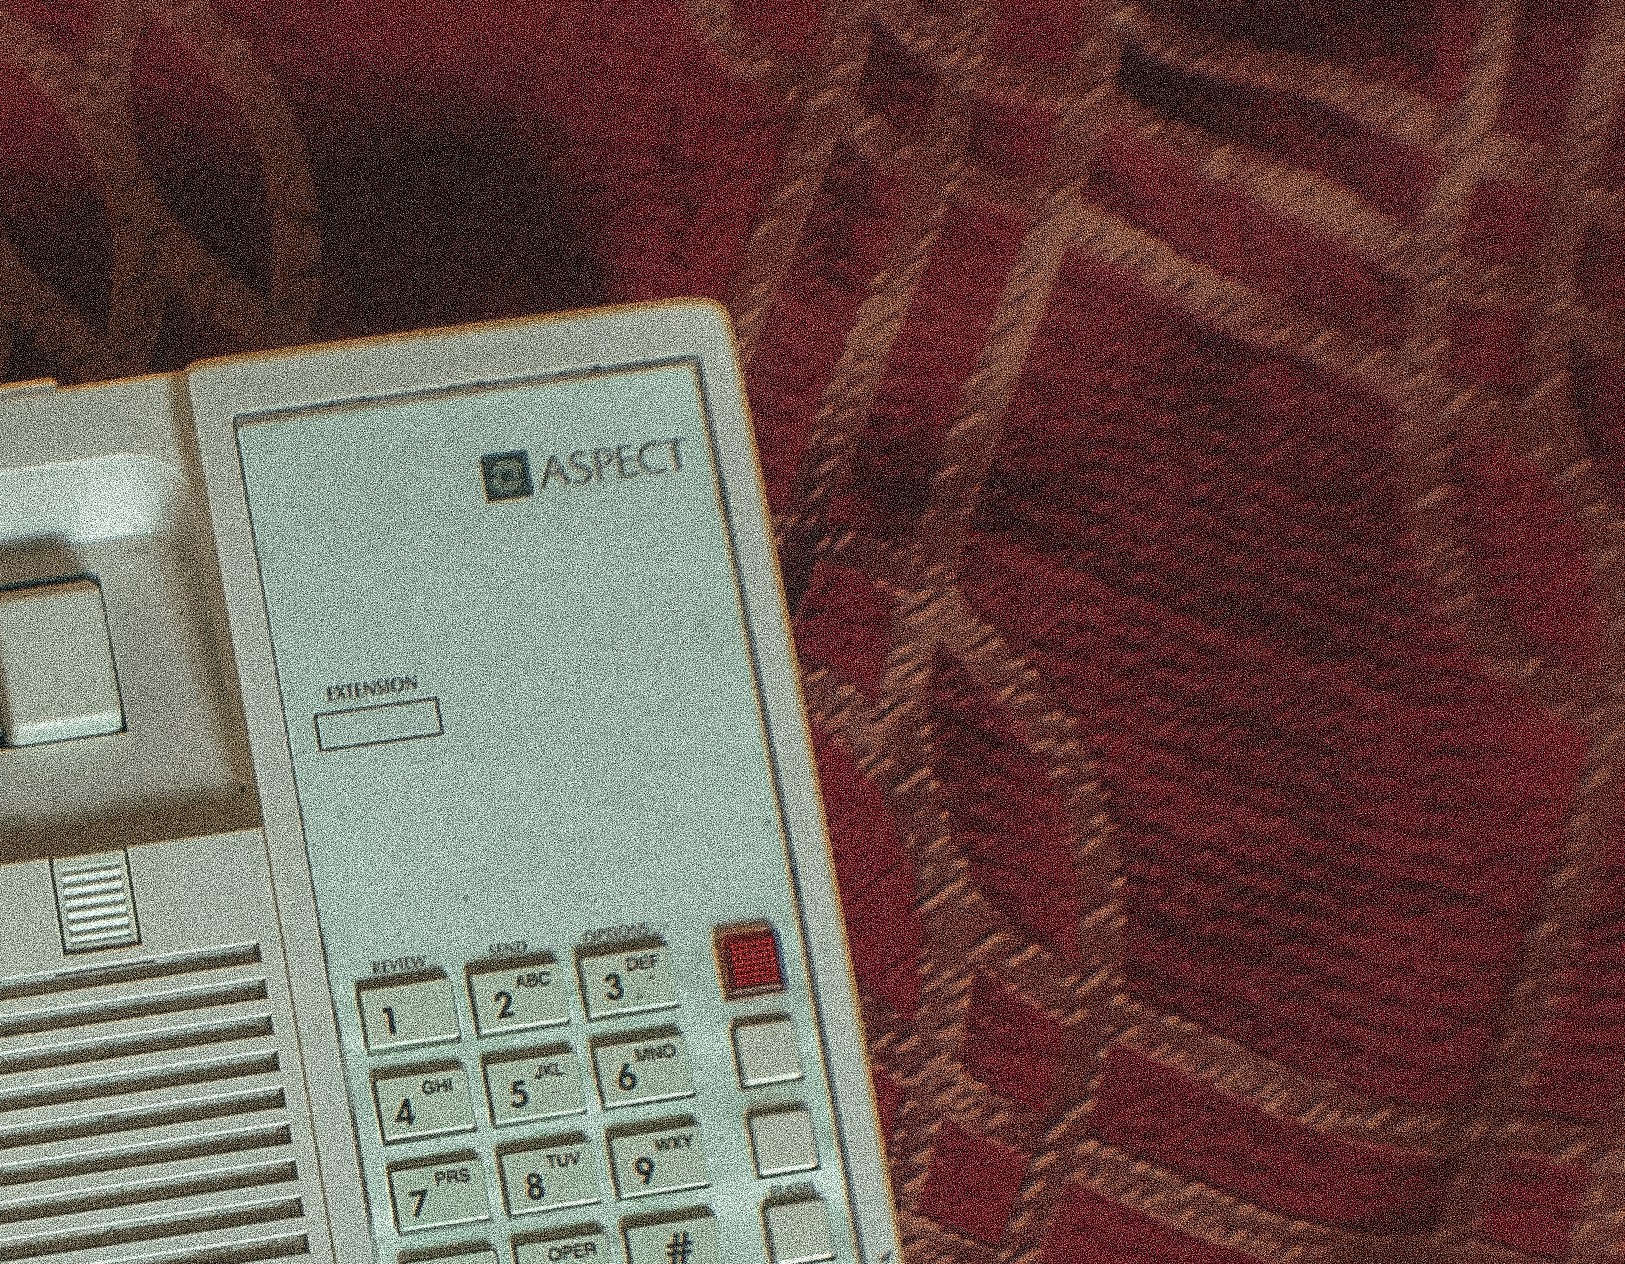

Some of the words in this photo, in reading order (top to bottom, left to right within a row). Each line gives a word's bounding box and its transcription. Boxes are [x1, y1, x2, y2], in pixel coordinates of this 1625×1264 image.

[541, 439, 684, 488] ASPECT
[327, 675, 418, 701] EXTENSION
[372, 956, 426, 973] REVIEW
[625, 954, 657, 971] DEF
[515, 969, 552, 988] ABC
[602, 973, 624, 1001] 3
[494, 991, 514, 1020] 2
[382, 1006, 397, 1036] 1
[633, 1043, 676, 1061] MNO
[534, 1062, 564, 1079] JKL
[616, 1063, 638, 1091] 6
[421, 1078, 454, 1095] GHI
[510, 1080, 528, 1108] 5
[394, 1098, 416, 1126] 4
[654, 1134, 693, 1151] WXY
[546, 1152, 578, 1168] TUV
[632, 1157, 655, 1185] 9
[433, 1168, 471, 1186] PRS
[525, 1172, 545, 1201] 8
[408, 1190, 428, 1218] 7
[547, 1240, 596, 1262] OPER
